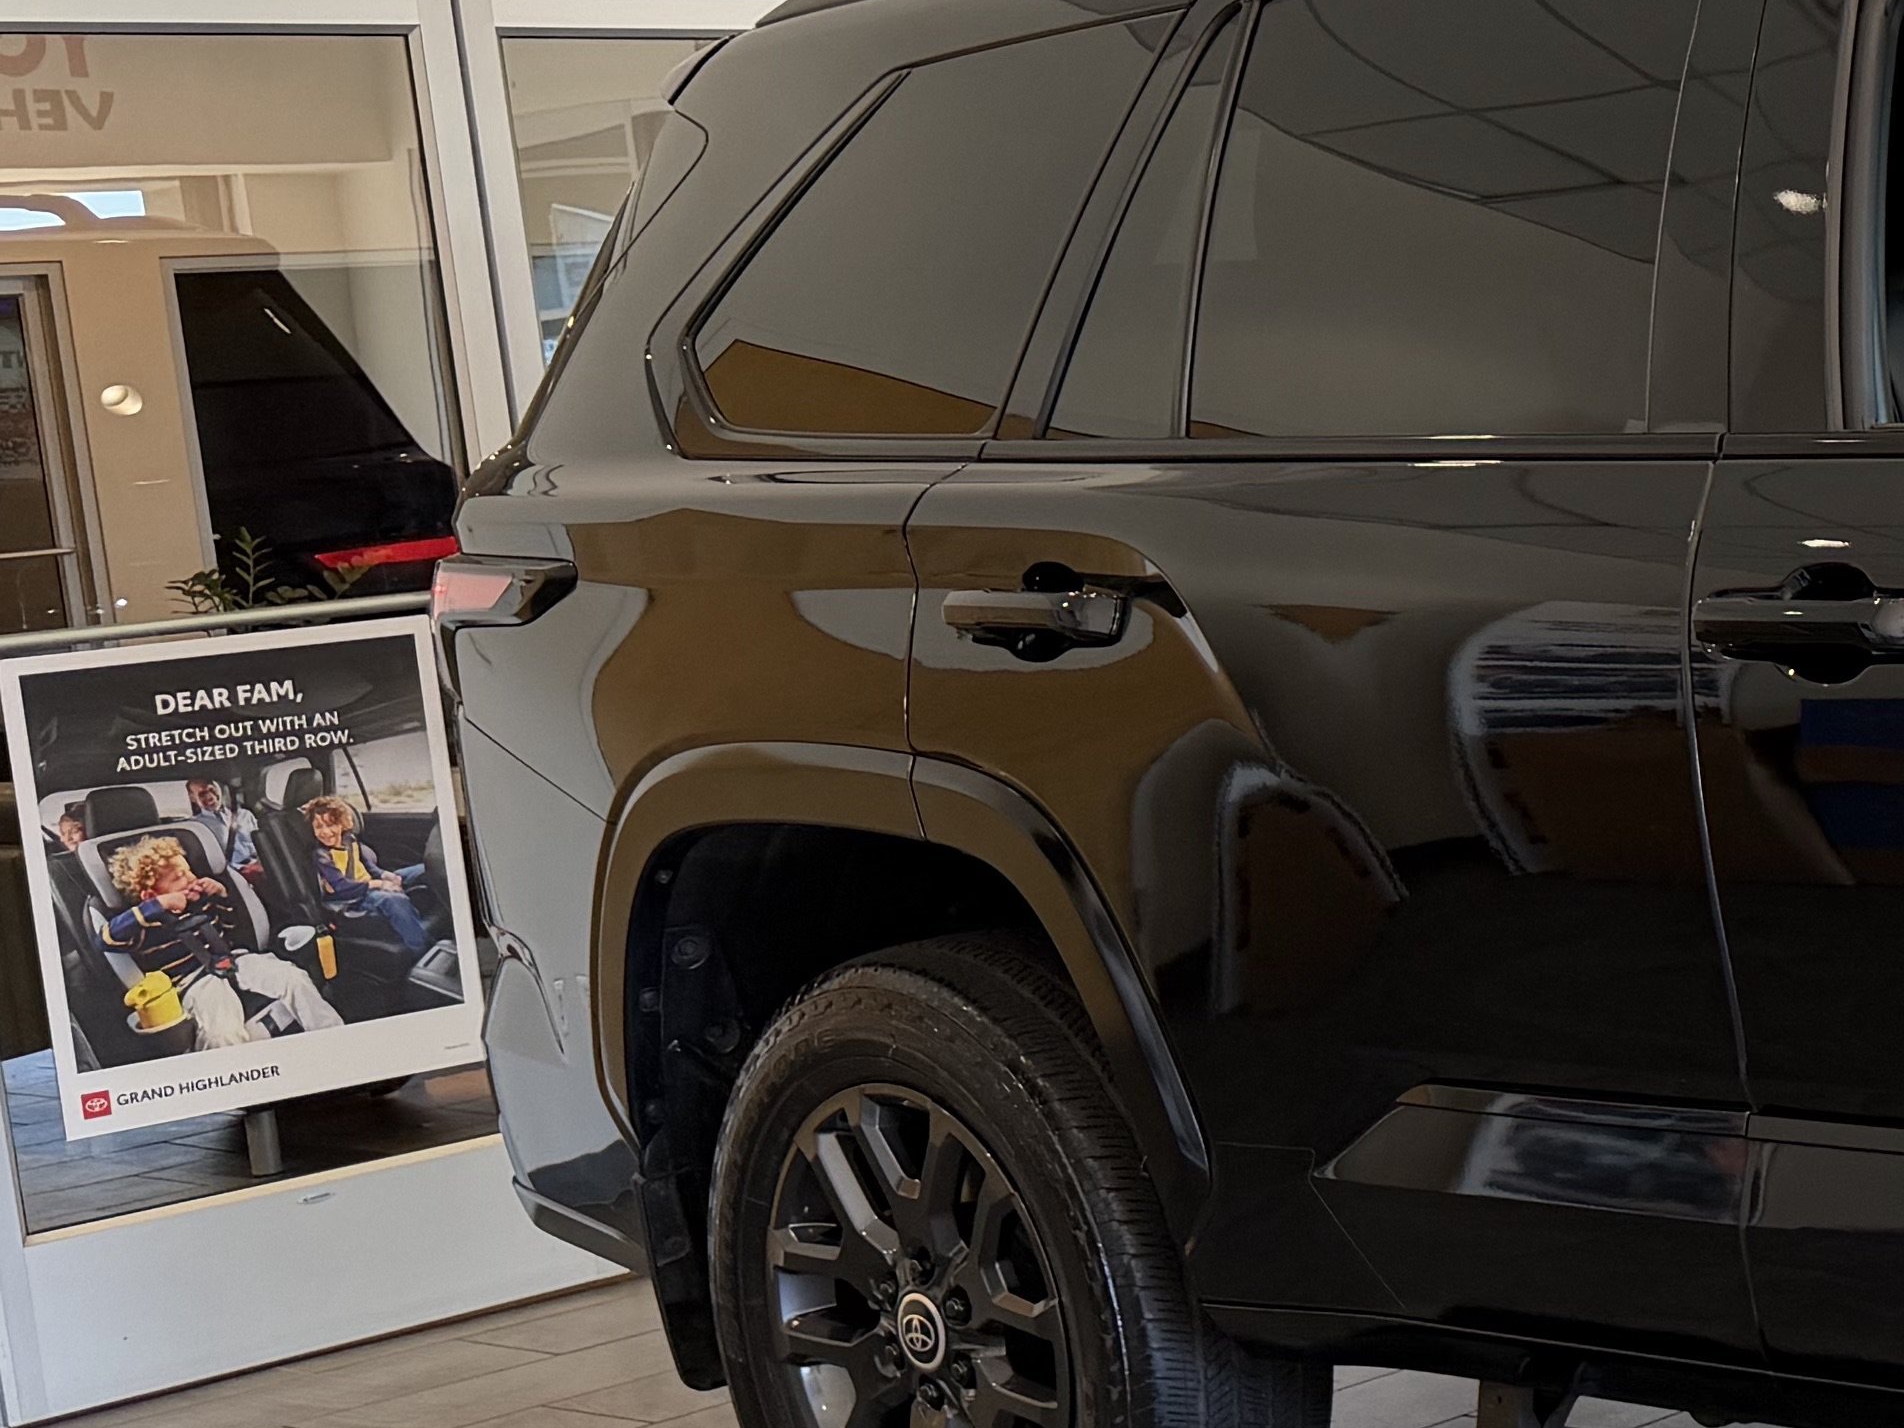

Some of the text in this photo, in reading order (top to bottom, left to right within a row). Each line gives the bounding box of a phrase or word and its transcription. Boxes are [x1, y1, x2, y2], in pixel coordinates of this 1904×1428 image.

[154, 679, 303, 715] DEAR FAM,
[116, 729, 354, 772] ADULT-SIZED THIRD ROW.
[125, 710, 340, 750] STRETCH OUT WITH AN
[116, 1065, 280, 1107] GRAND HIGHLANDER
